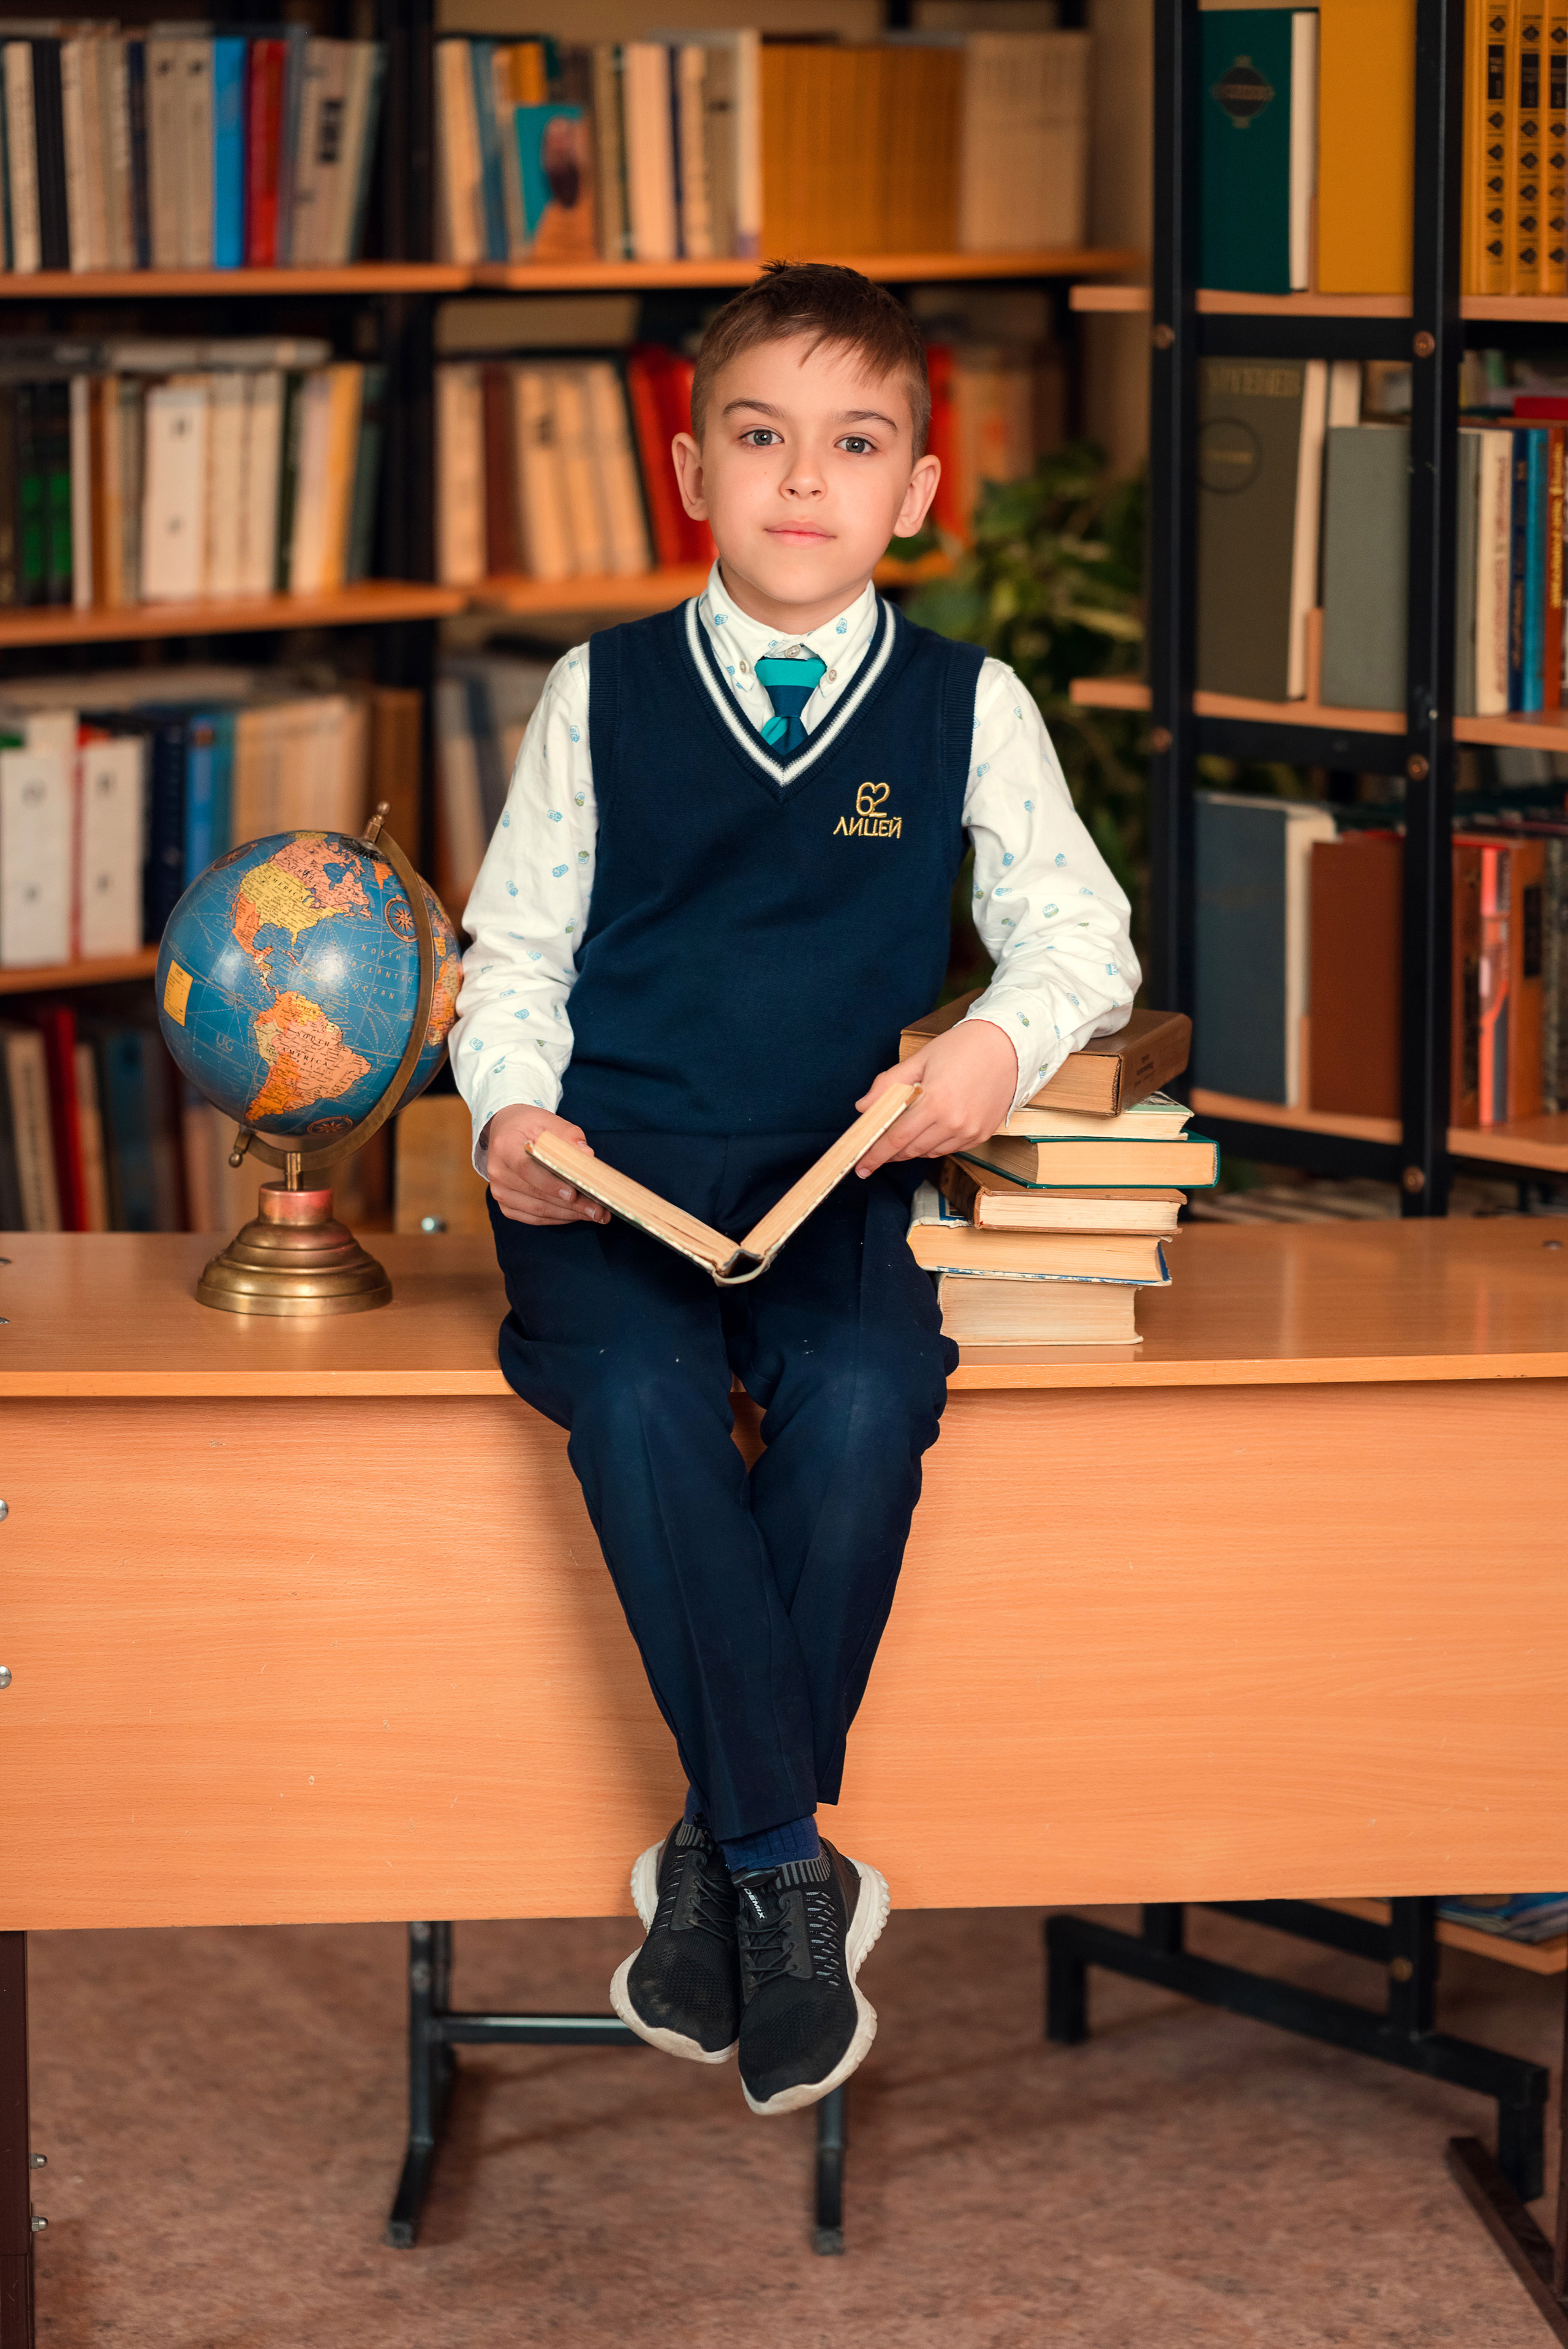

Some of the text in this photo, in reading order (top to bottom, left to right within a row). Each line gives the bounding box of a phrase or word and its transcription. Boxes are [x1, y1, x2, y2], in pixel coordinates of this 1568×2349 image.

[856, 782, 890, 818] 62
[833, 816, 902, 839] ЛИЦЕЙ
[267, 875, 304, 900] AMERICA
[361, 944, 401, 960] NORTH
[351, 961, 413, 983] ATLANTIC
[353, 982, 395, 999] OCEAN
[296, 1031, 330, 1046] SOUTH
[282, 1047, 328, 1067] AMERICA
[744, 1888, 765, 1918] DEMIX
